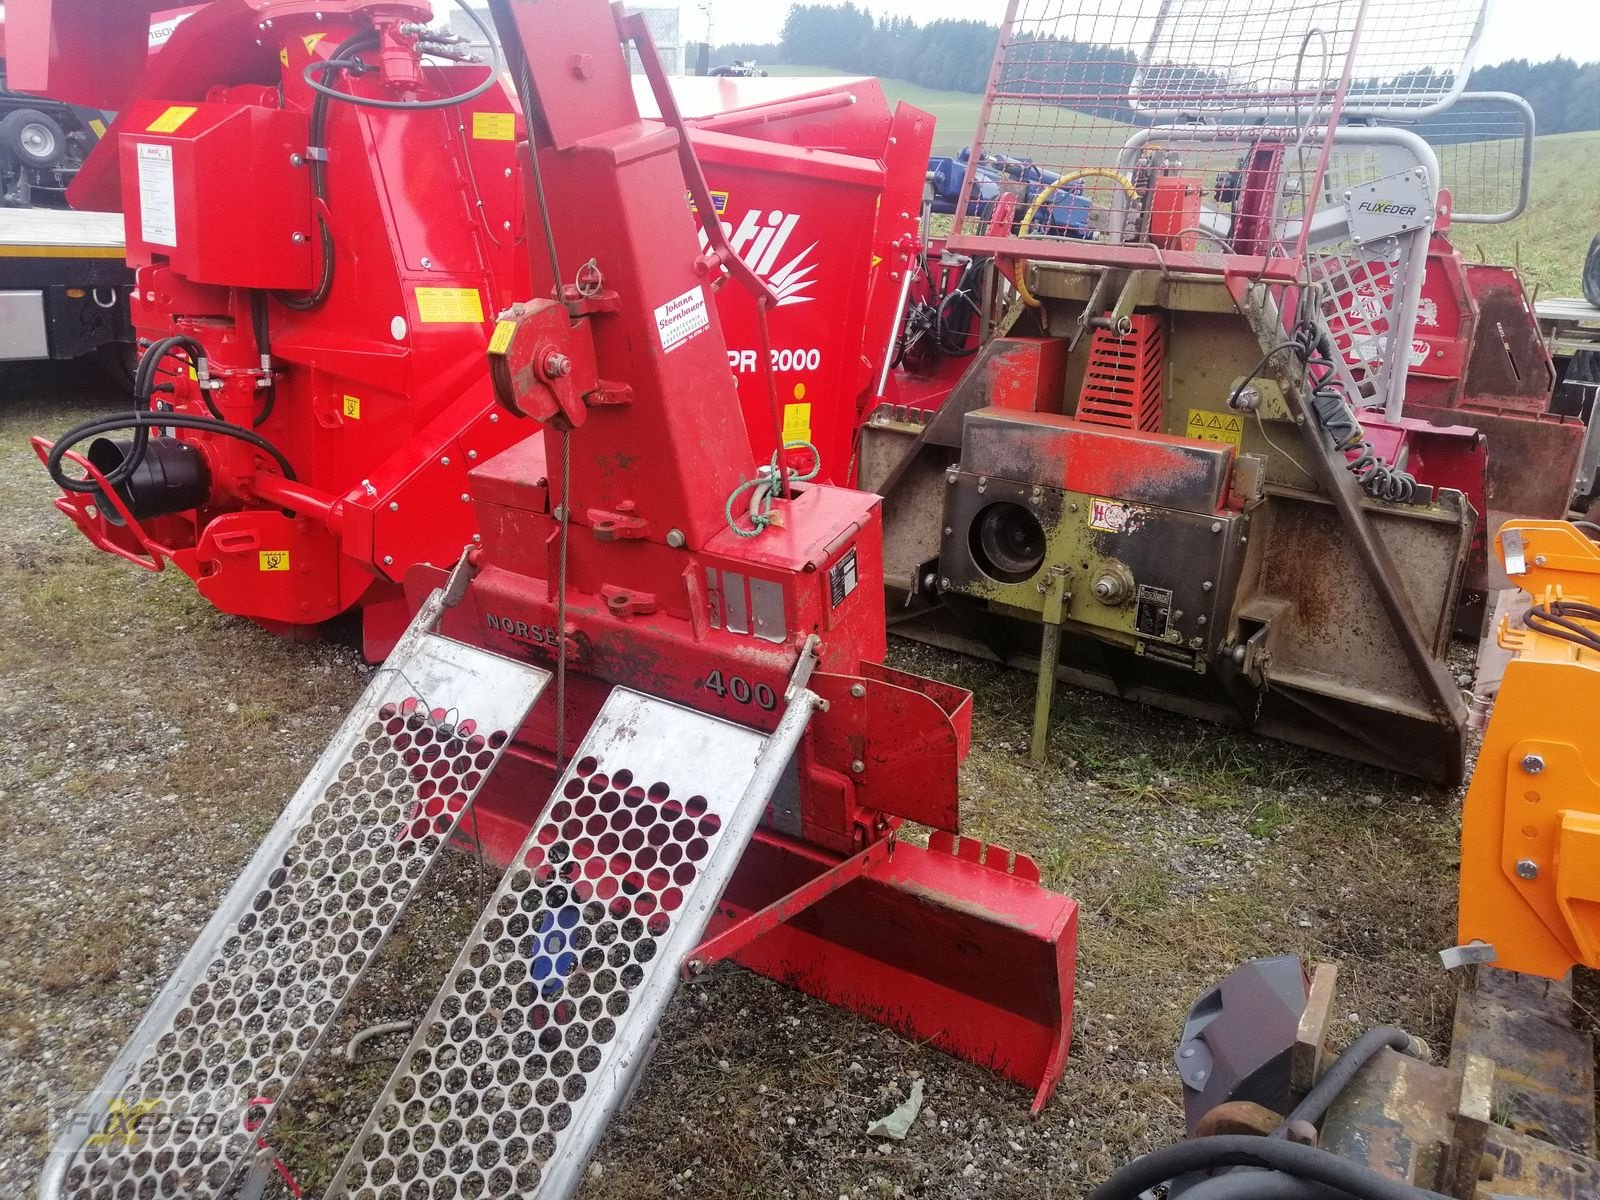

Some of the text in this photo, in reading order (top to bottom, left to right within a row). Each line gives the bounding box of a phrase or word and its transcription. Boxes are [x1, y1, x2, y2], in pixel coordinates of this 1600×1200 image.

[1358, 201, 1417, 216] FLIXEDER
[659, 300, 704, 330] Sternbauer
[665, 294, 694, 317] Johann
[726, 348, 820, 373] PR 2000
[486, 612, 560, 647] NORSE
[705, 669, 778, 711] 400
